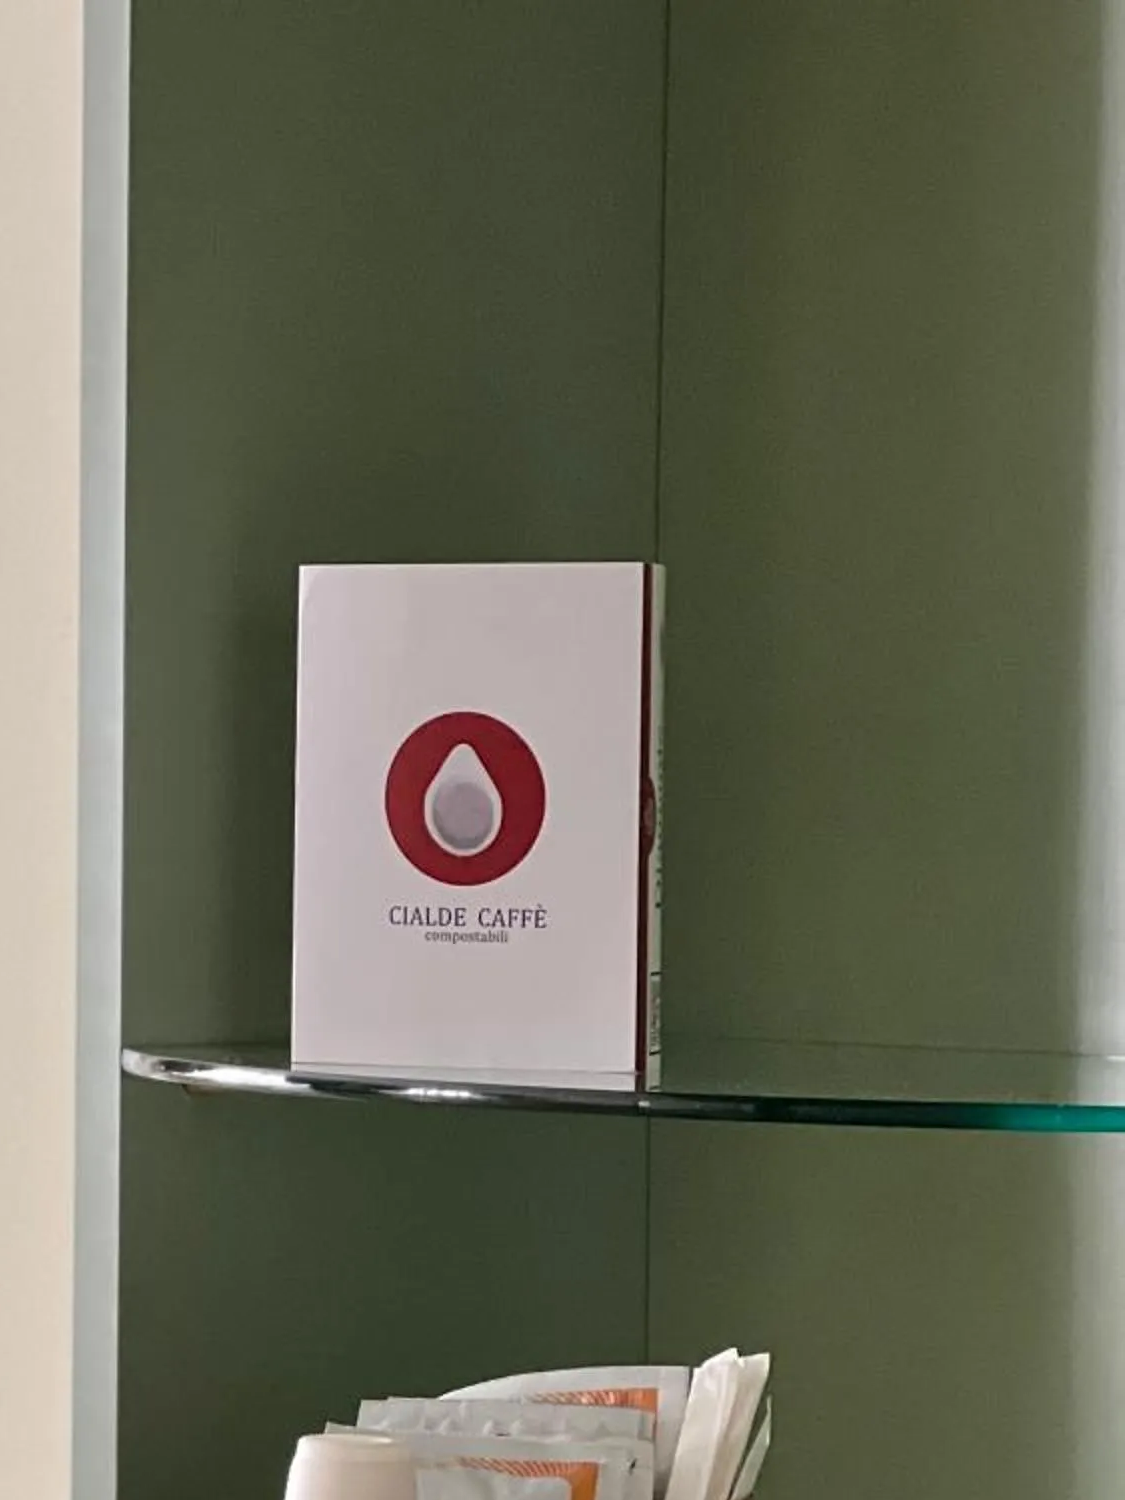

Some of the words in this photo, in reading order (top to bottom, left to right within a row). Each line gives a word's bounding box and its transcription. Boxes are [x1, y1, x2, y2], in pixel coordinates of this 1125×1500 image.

[389, 905, 467, 927] CIALDE
[477, 904, 548, 929] CAFFÈ
[424, 930, 509, 944] compostabili
